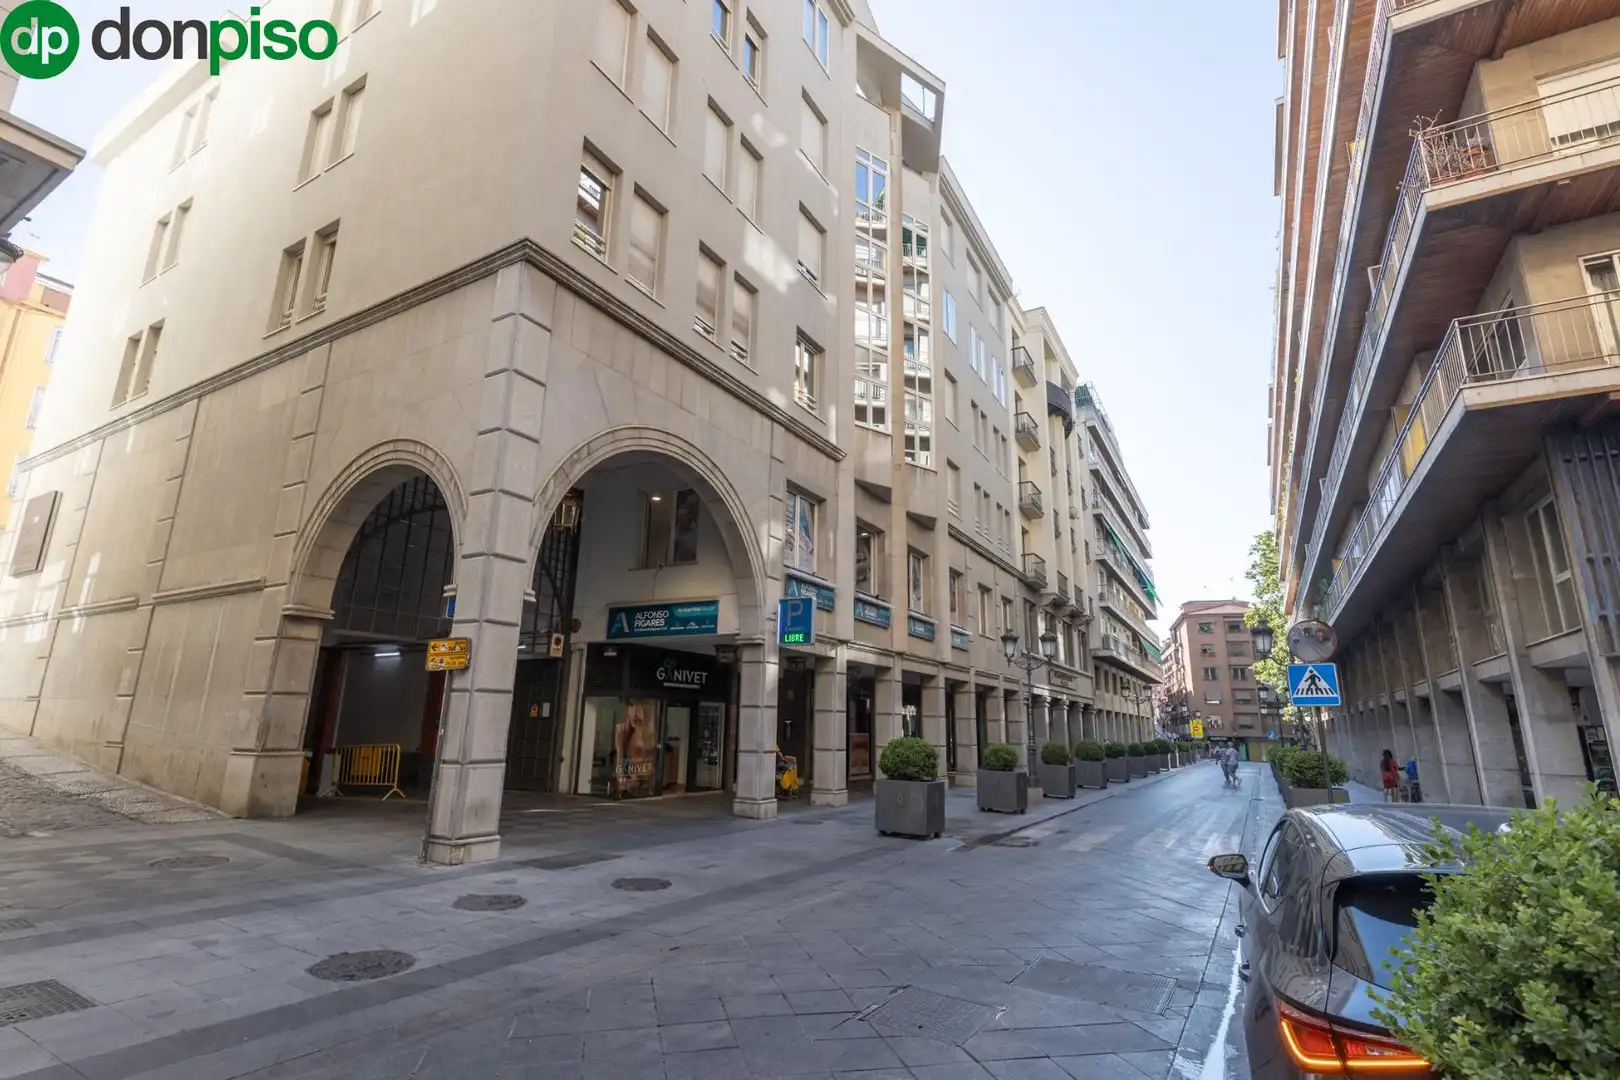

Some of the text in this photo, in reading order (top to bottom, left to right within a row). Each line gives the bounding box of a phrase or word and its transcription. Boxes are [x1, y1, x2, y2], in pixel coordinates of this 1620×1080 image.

[635, 610, 669, 620] ALFONSO
[787, 600, 803, 626] P
[634, 618, 665, 627] FIGARES
[784, 633, 804, 642] LIBRE
